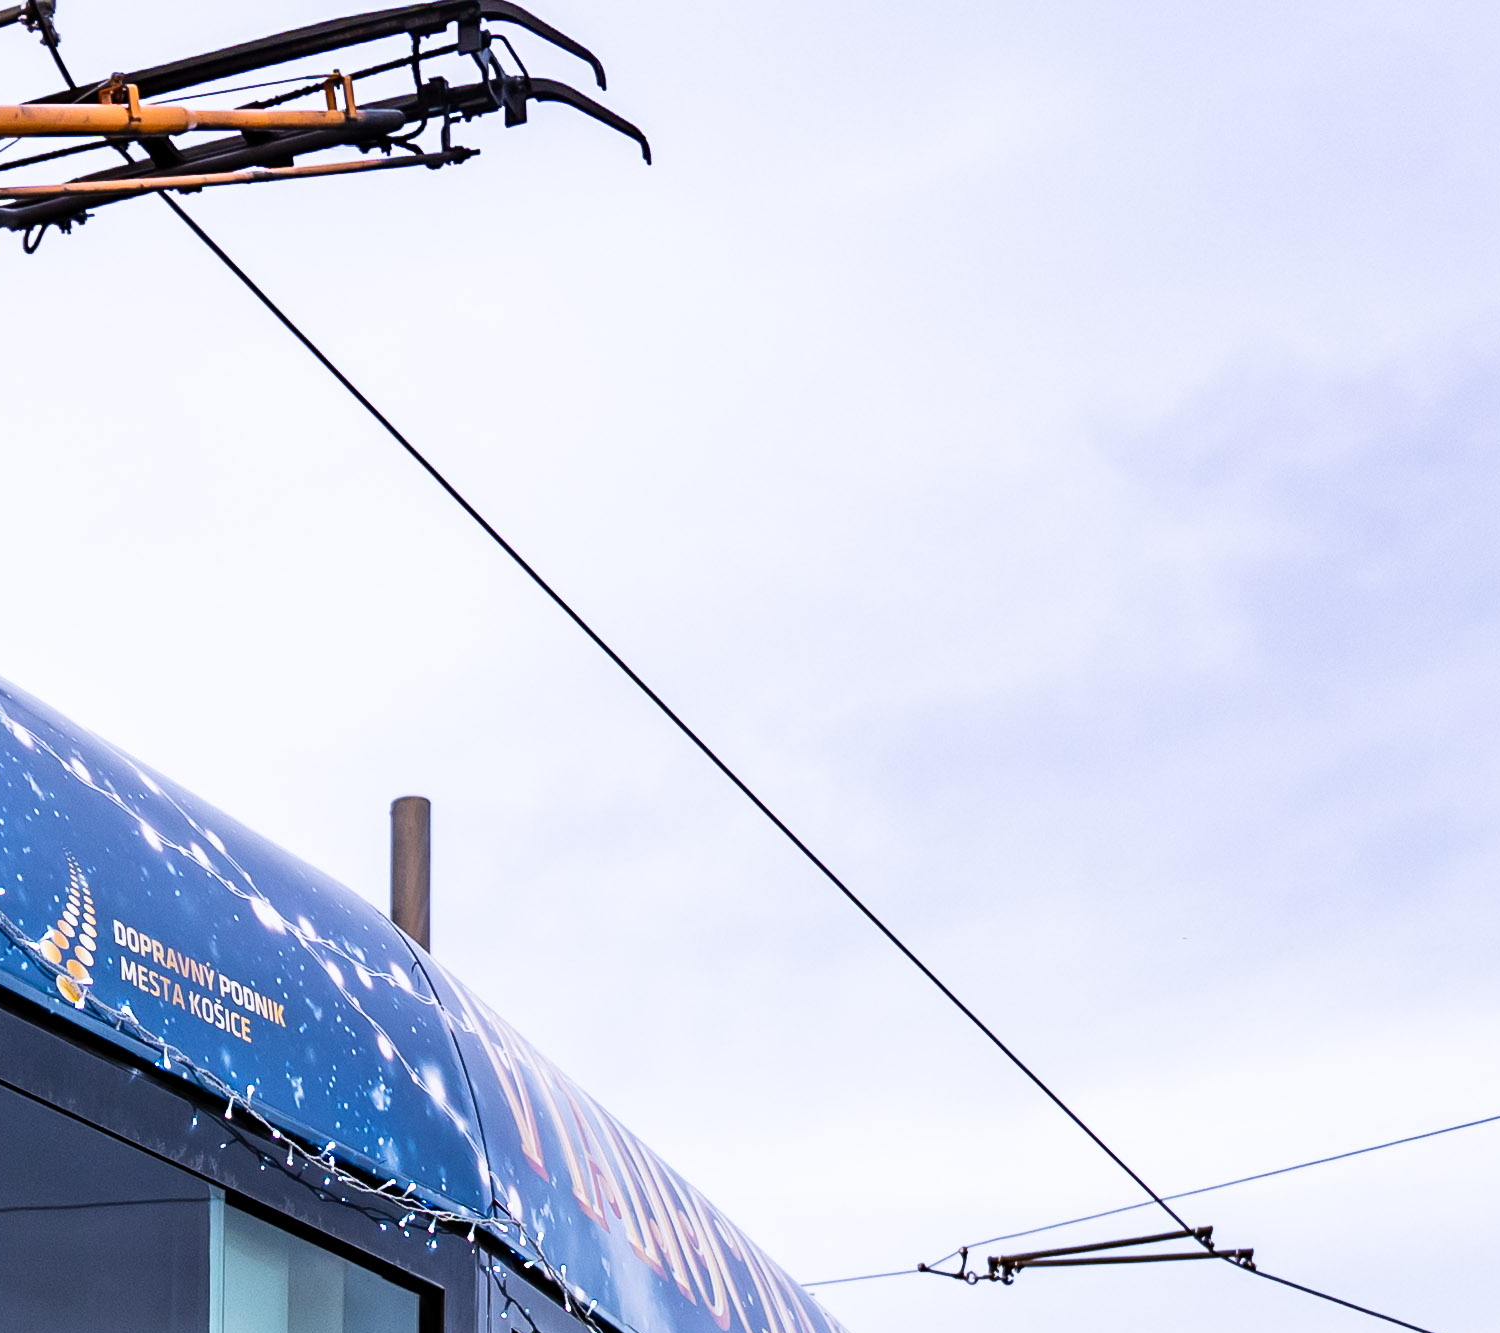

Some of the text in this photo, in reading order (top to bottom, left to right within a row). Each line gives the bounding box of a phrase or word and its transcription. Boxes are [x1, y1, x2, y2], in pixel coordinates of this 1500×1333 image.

[112, 918, 288, 1028] DOPRAVNÝ PODNIK
[119, 955, 253, 1044] MESTA KOŠICE
